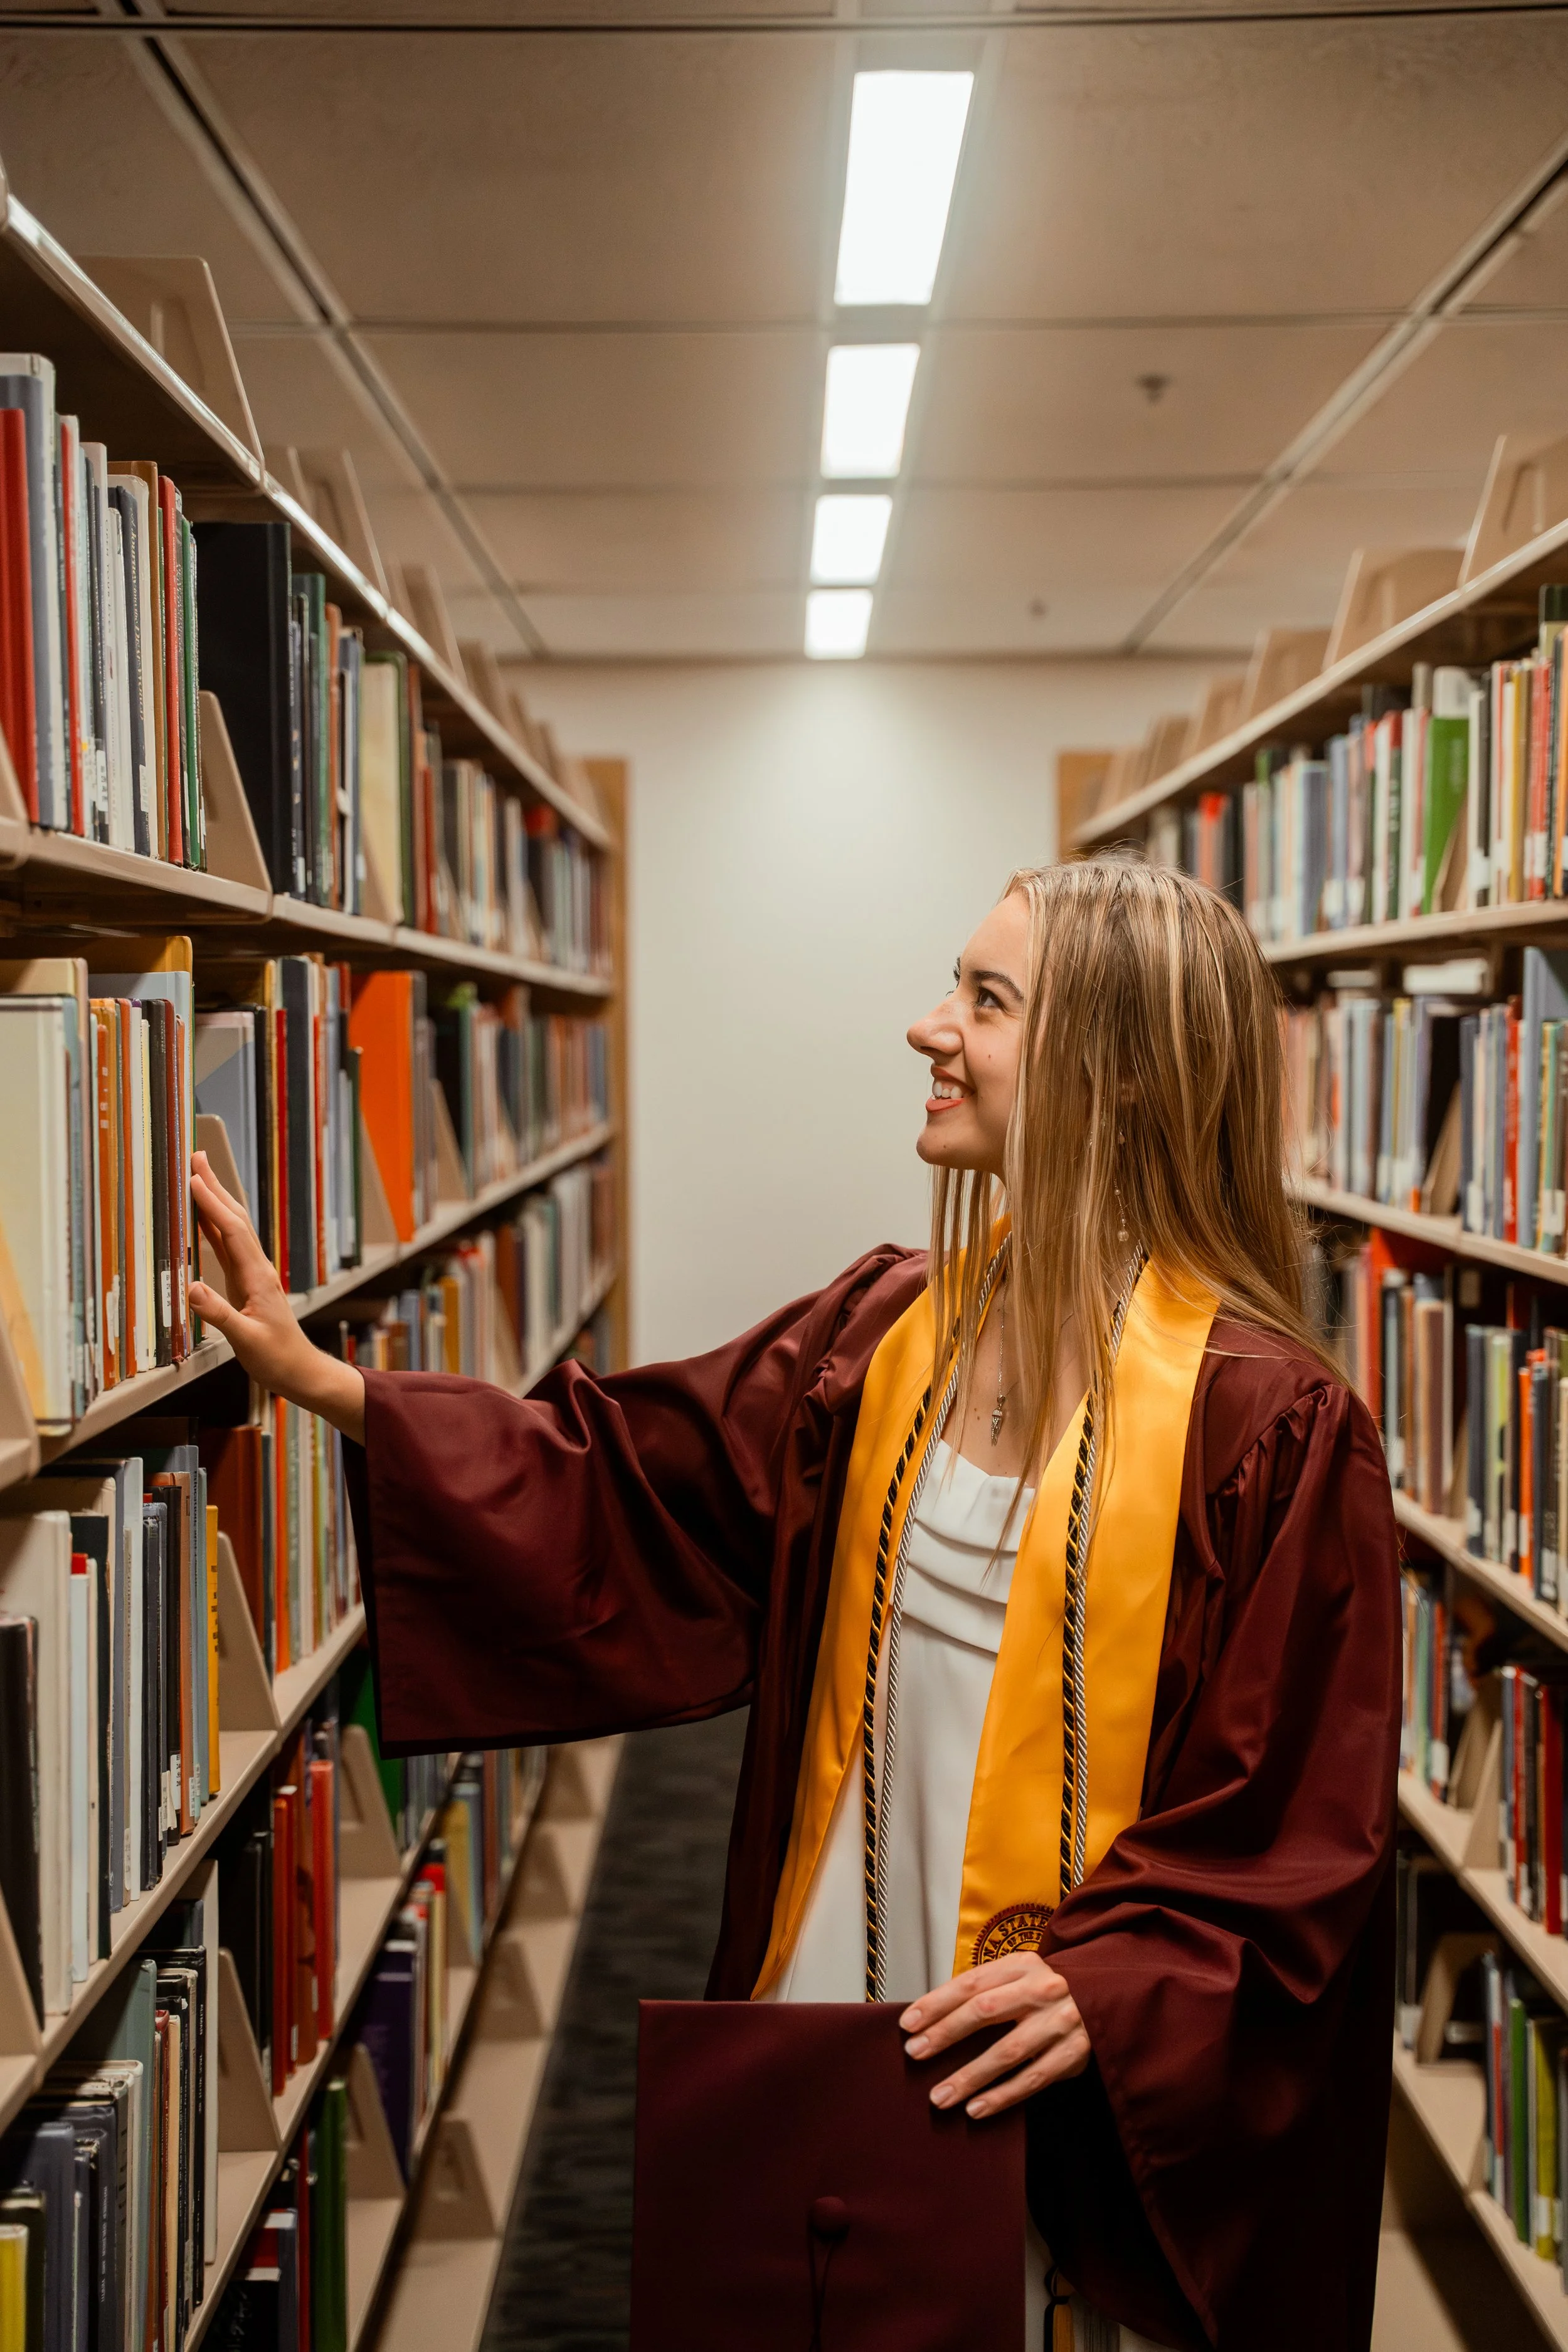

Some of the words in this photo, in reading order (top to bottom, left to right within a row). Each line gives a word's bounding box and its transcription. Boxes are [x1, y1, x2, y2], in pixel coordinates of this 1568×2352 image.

[998, 1914, 1049, 1937] STATE
[1007, 1936, 1017, 1947] OF
[1018, 1931, 1034, 1942] THE
